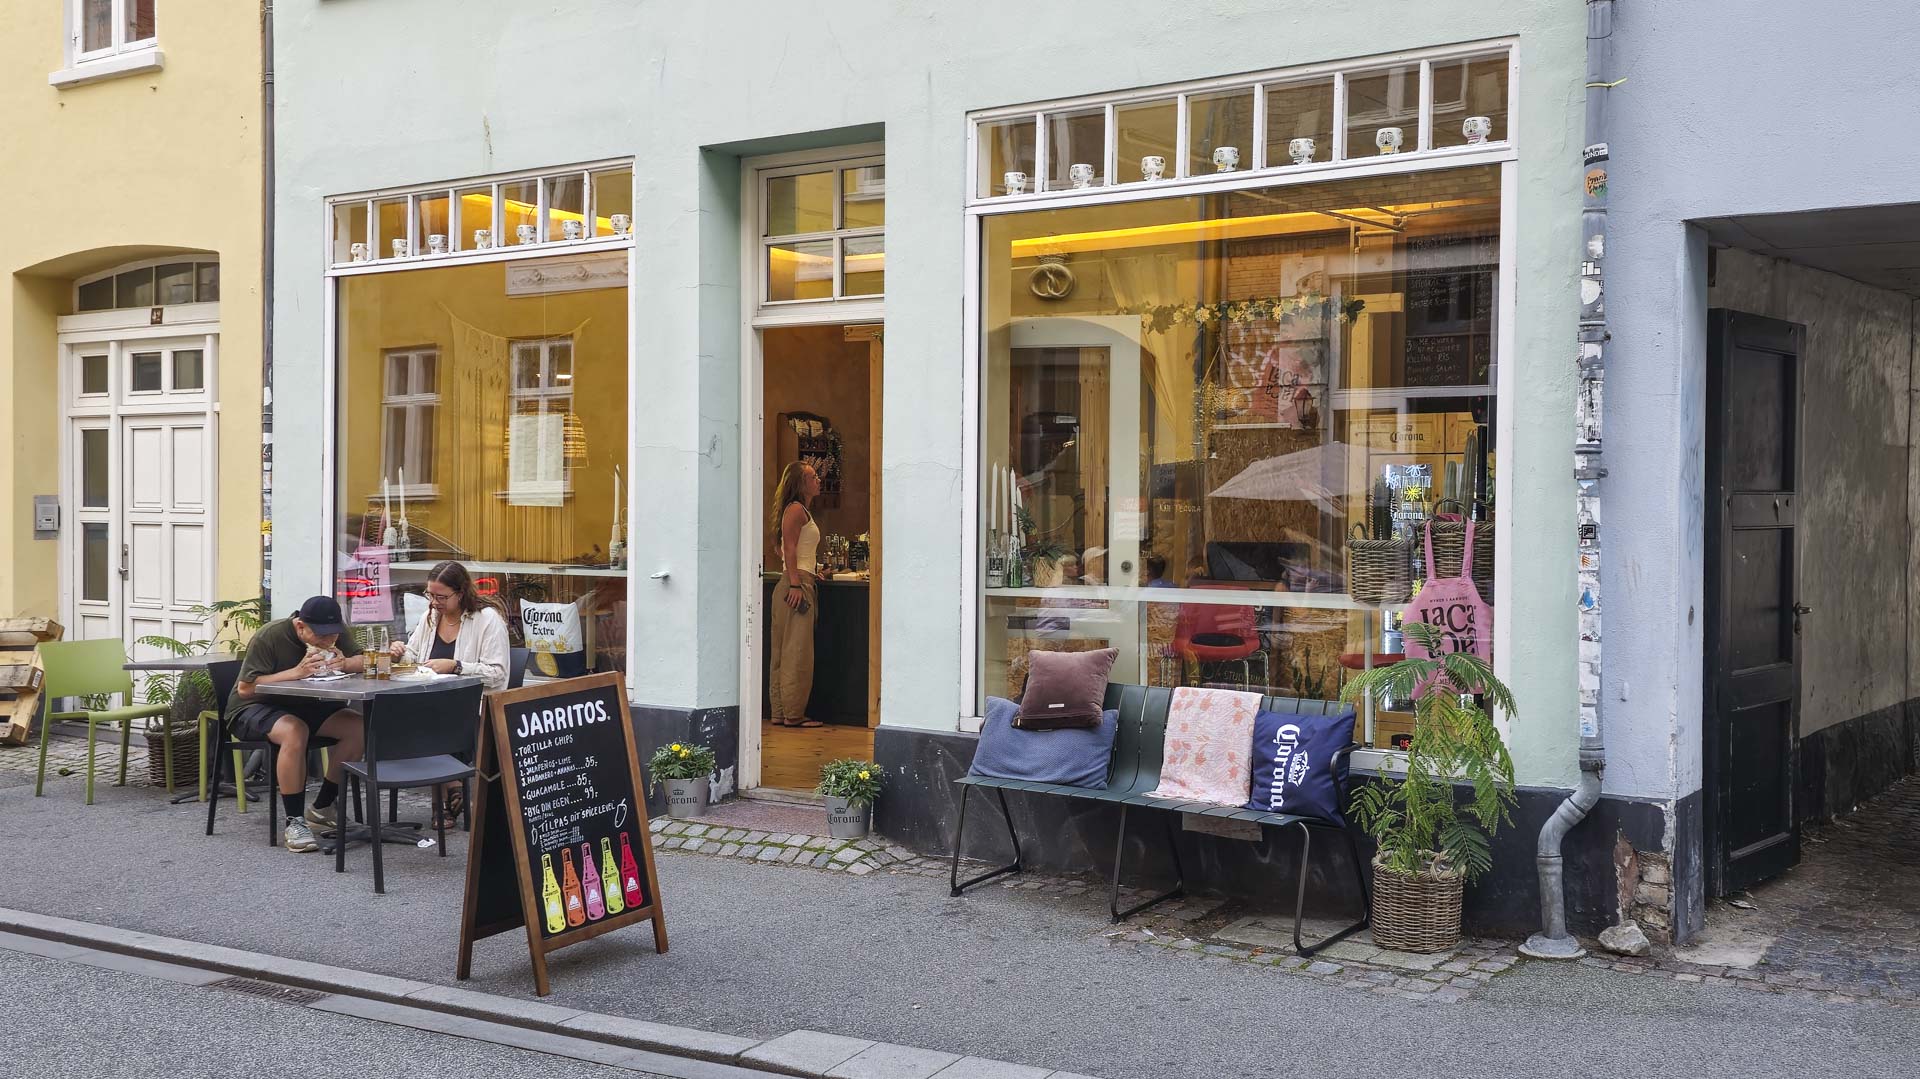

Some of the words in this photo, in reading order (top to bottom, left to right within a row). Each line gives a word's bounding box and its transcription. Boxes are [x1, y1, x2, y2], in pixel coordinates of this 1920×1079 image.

[1389, 431, 1424, 443] Corona
[523, 607, 563, 626] Corona
[532, 623, 555, 636] Extra
[518, 739, 553, 757] TORTILLA
[554, 734, 574, 746] CHIPS
[1269, 723, 1300, 809] Corona
[664, 794, 697, 805] Corona
[538, 816, 569, 832] TILPAS
[827, 812, 861, 825] Corona
